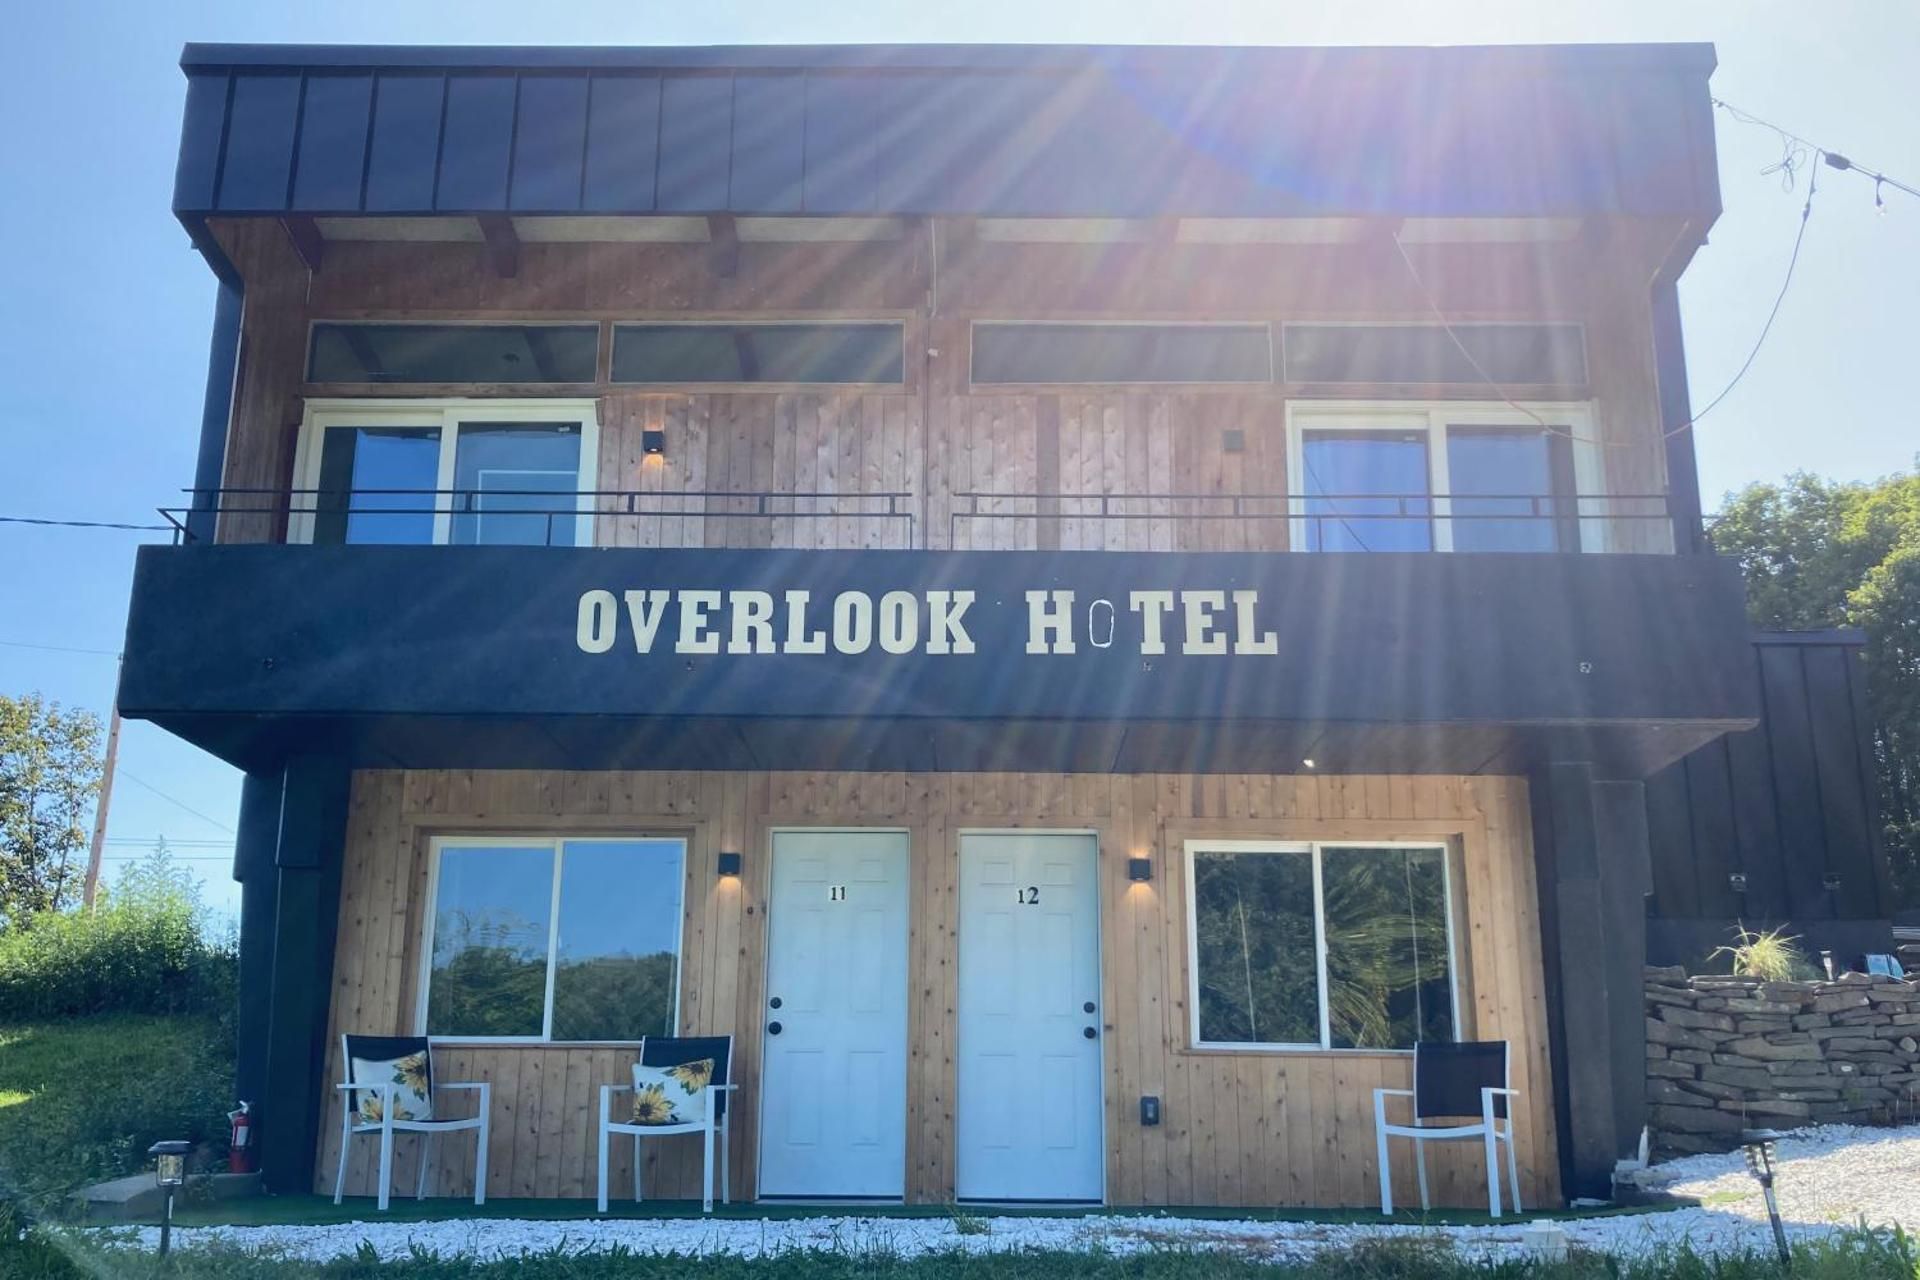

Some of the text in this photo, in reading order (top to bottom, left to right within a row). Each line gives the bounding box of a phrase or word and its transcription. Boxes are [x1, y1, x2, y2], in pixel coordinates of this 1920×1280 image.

[576, 589, 976, 655] OVERLOOK
[830, 886, 846, 901] 11
[1017, 886, 1040, 905] 12
